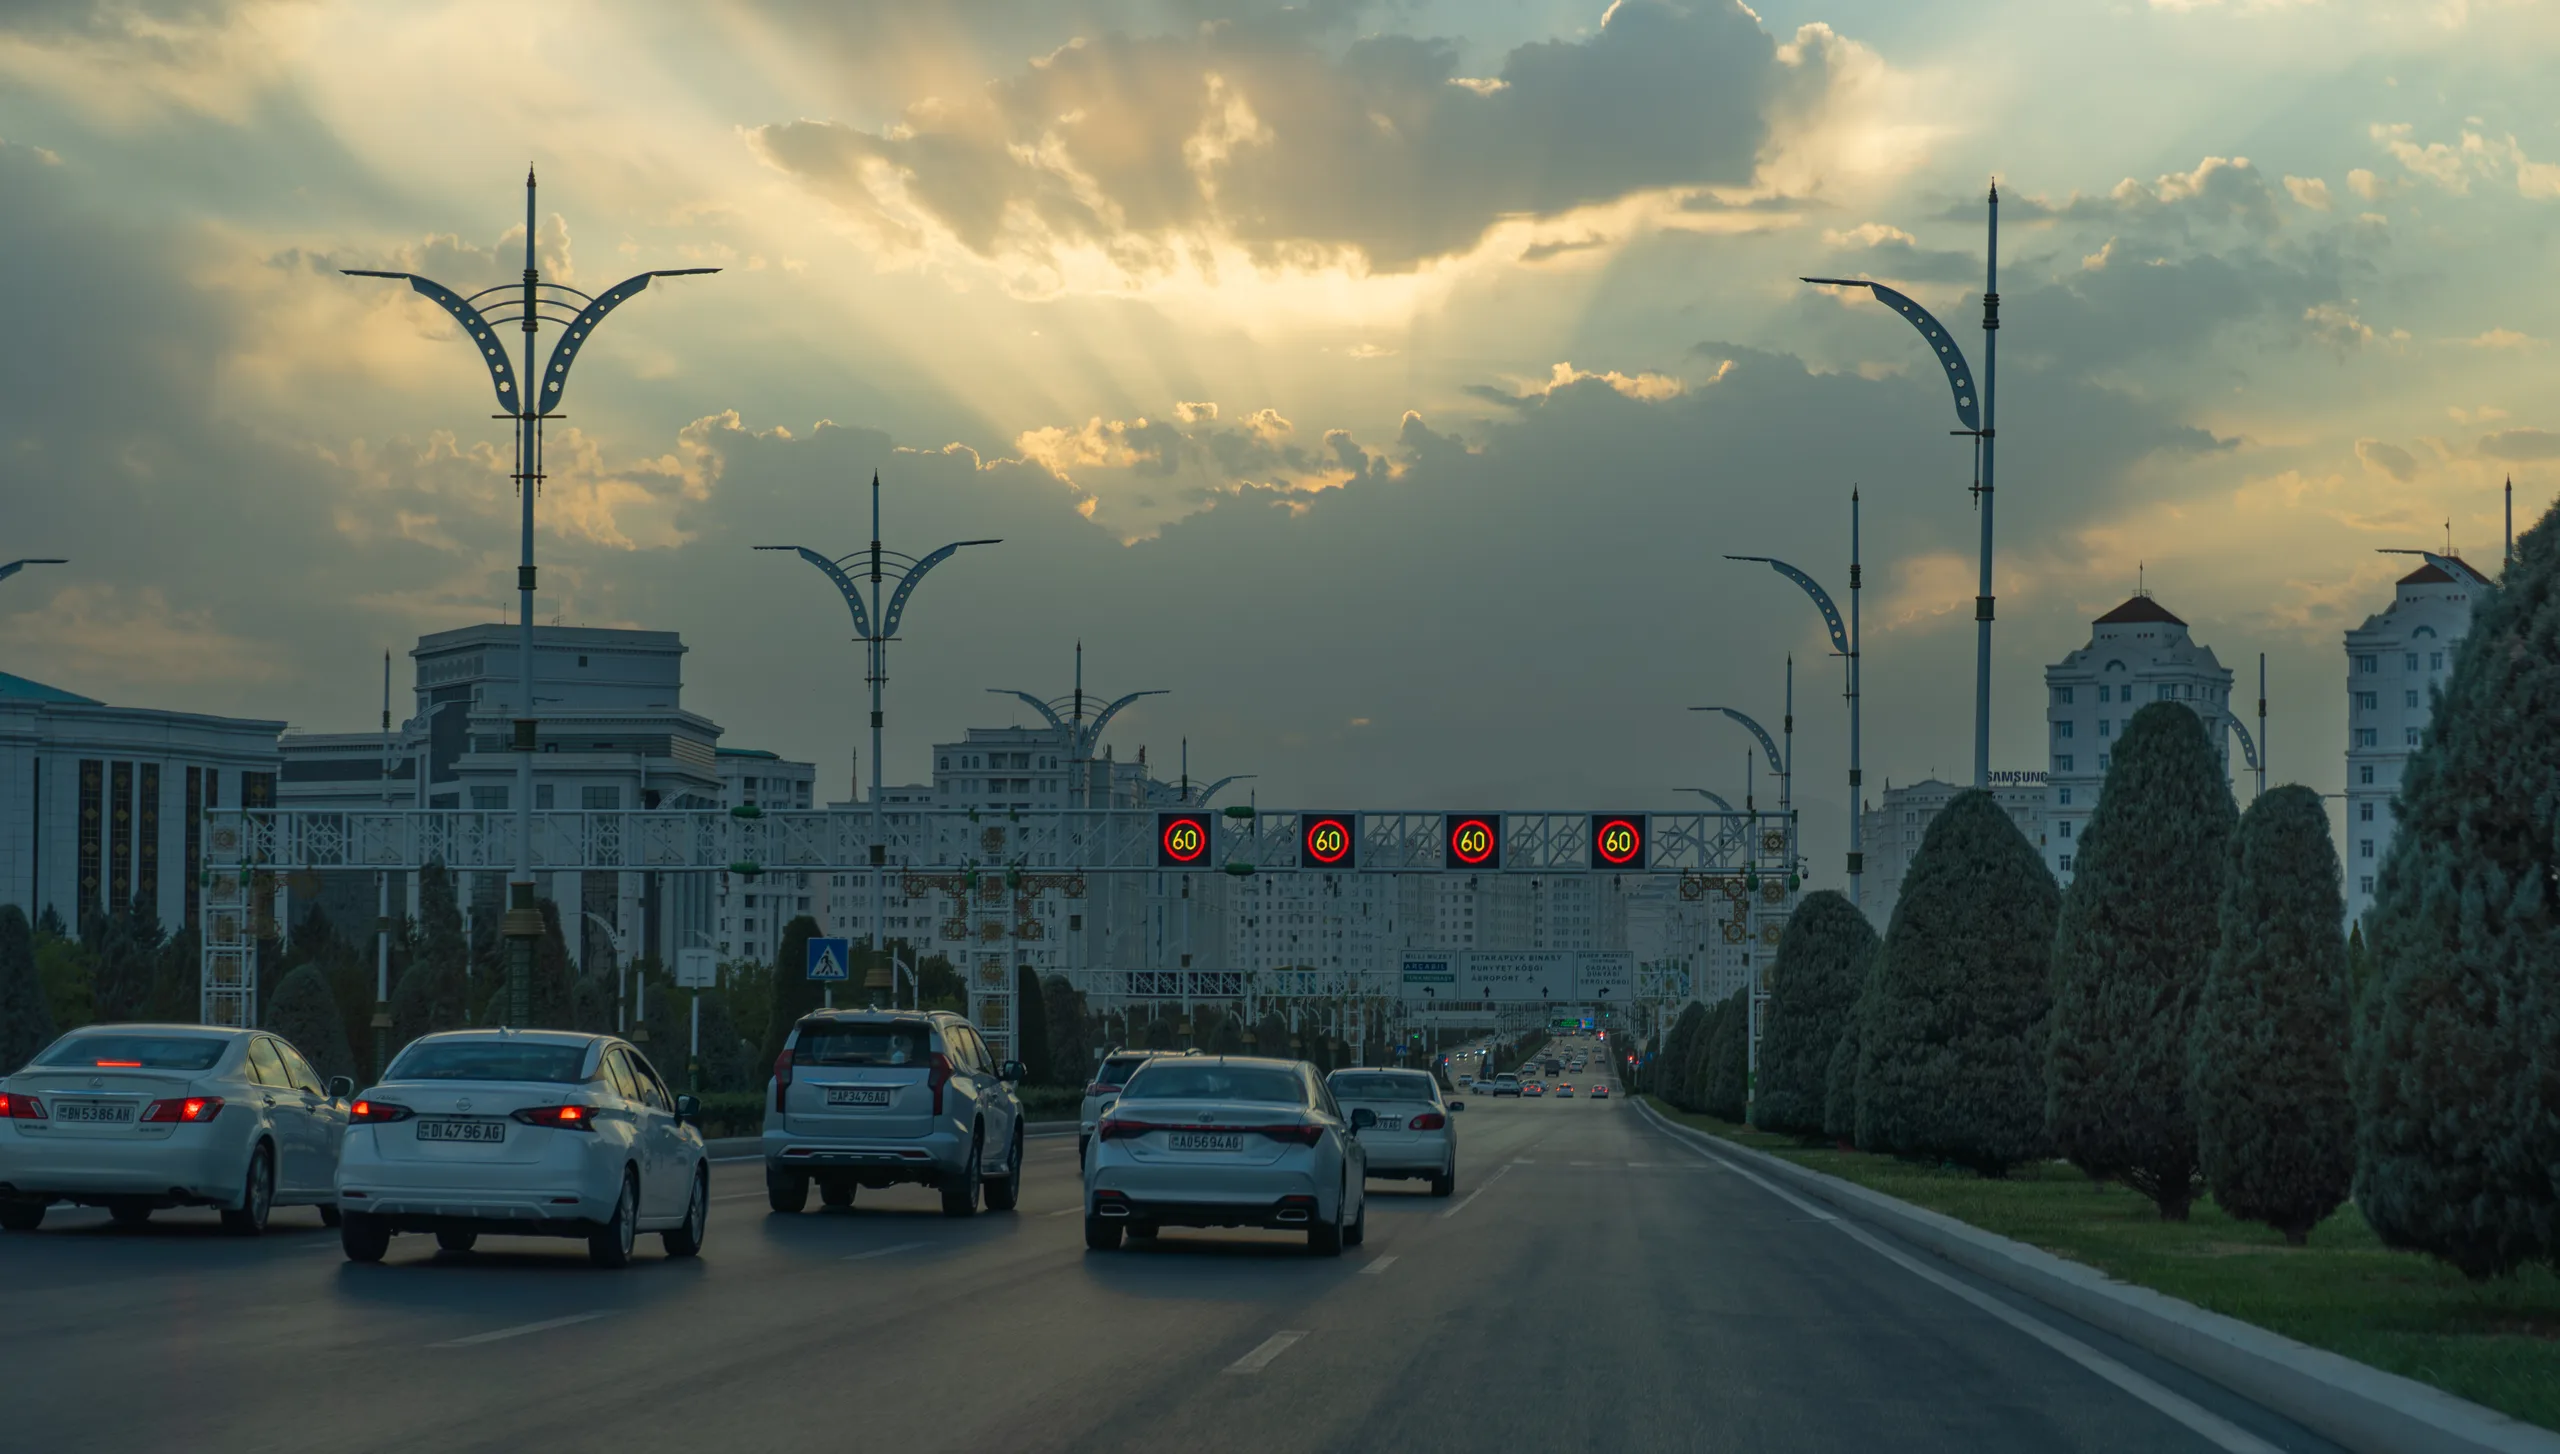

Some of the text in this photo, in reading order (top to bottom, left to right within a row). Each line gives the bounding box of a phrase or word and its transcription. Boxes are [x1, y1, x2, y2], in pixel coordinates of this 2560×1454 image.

[1172, 830, 1196, 852] 60
[1316, 830, 1341, 852] 60
[1460, 830, 1485, 852] 60
[1606, 831, 1631, 853] 60
[1528, 954, 1562, 962] BINASY
[82, 1107, 115, 1121] 5386
[444, 1124, 481, 1139] 4796
[484, 1125, 500, 1140] AG
